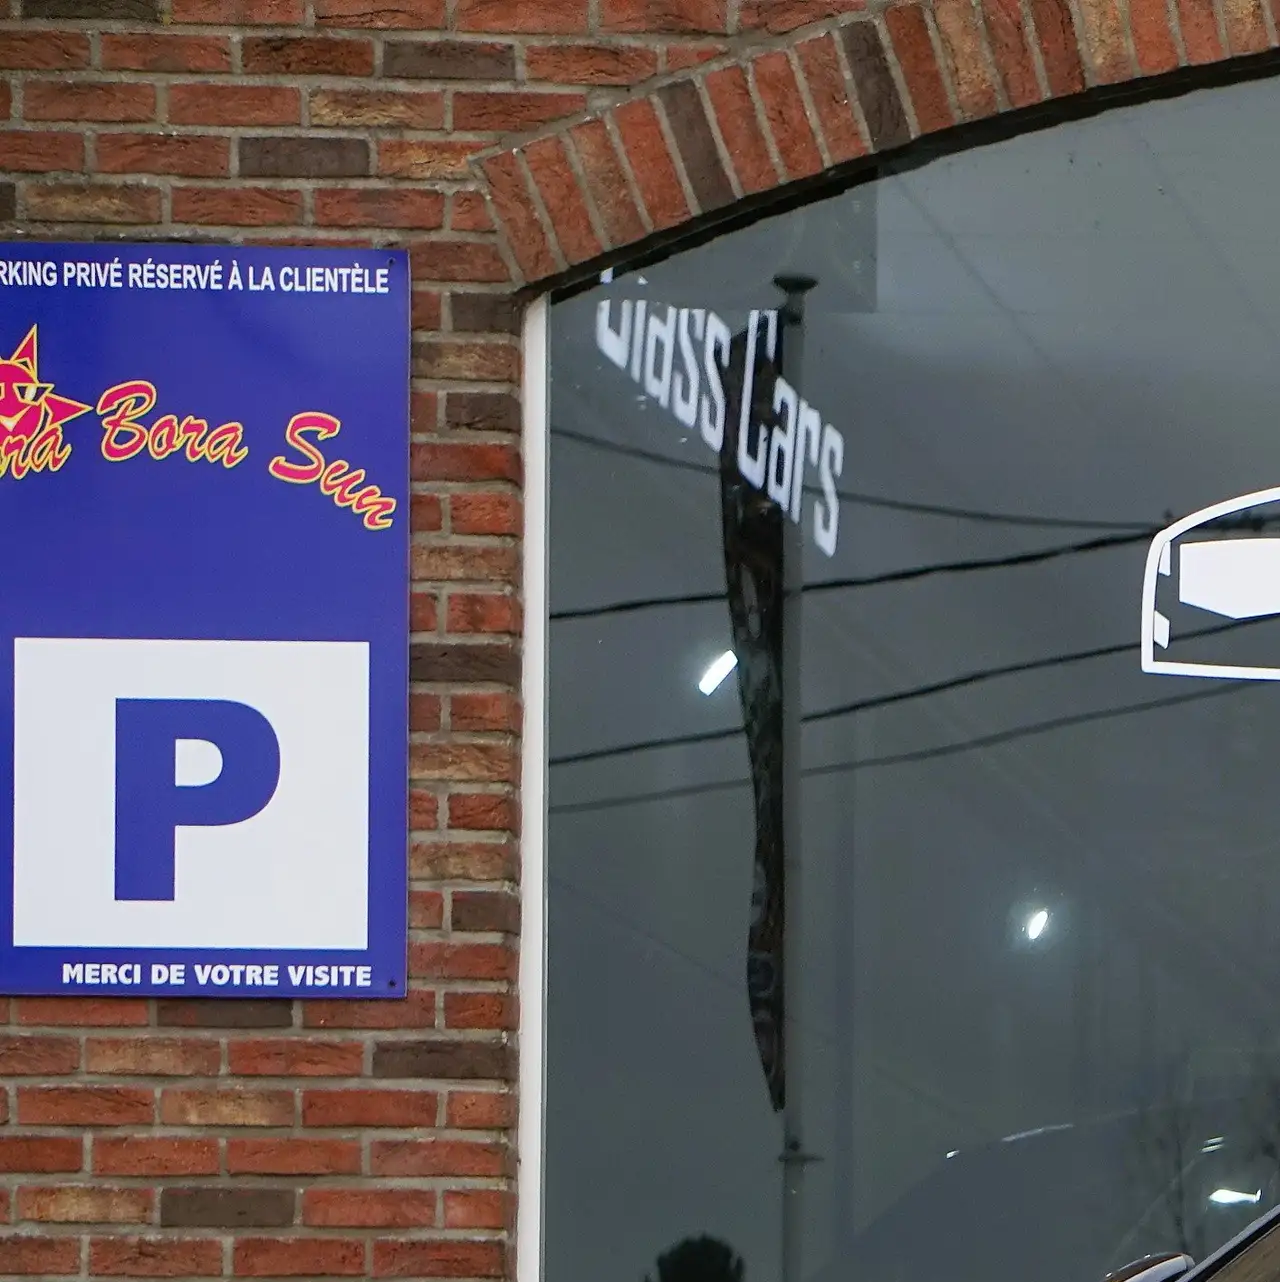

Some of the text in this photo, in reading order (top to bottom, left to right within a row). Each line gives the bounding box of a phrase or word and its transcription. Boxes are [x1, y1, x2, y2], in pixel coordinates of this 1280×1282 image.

[63, 257, 122, 288] PRIVÉ
[129, 260, 222, 290] RÉSERVÉ
[228, 260, 243, 290] À
[249, 266, 275, 291] LA
[280, 263, 389, 293] CLIENTÈLE
[97, 380, 248, 468] Bora
[269, 412, 397, 530] Sun
[114, 698, 281, 902] P
[62, 963, 372, 987] MERCI DE VOTRE VISITE
